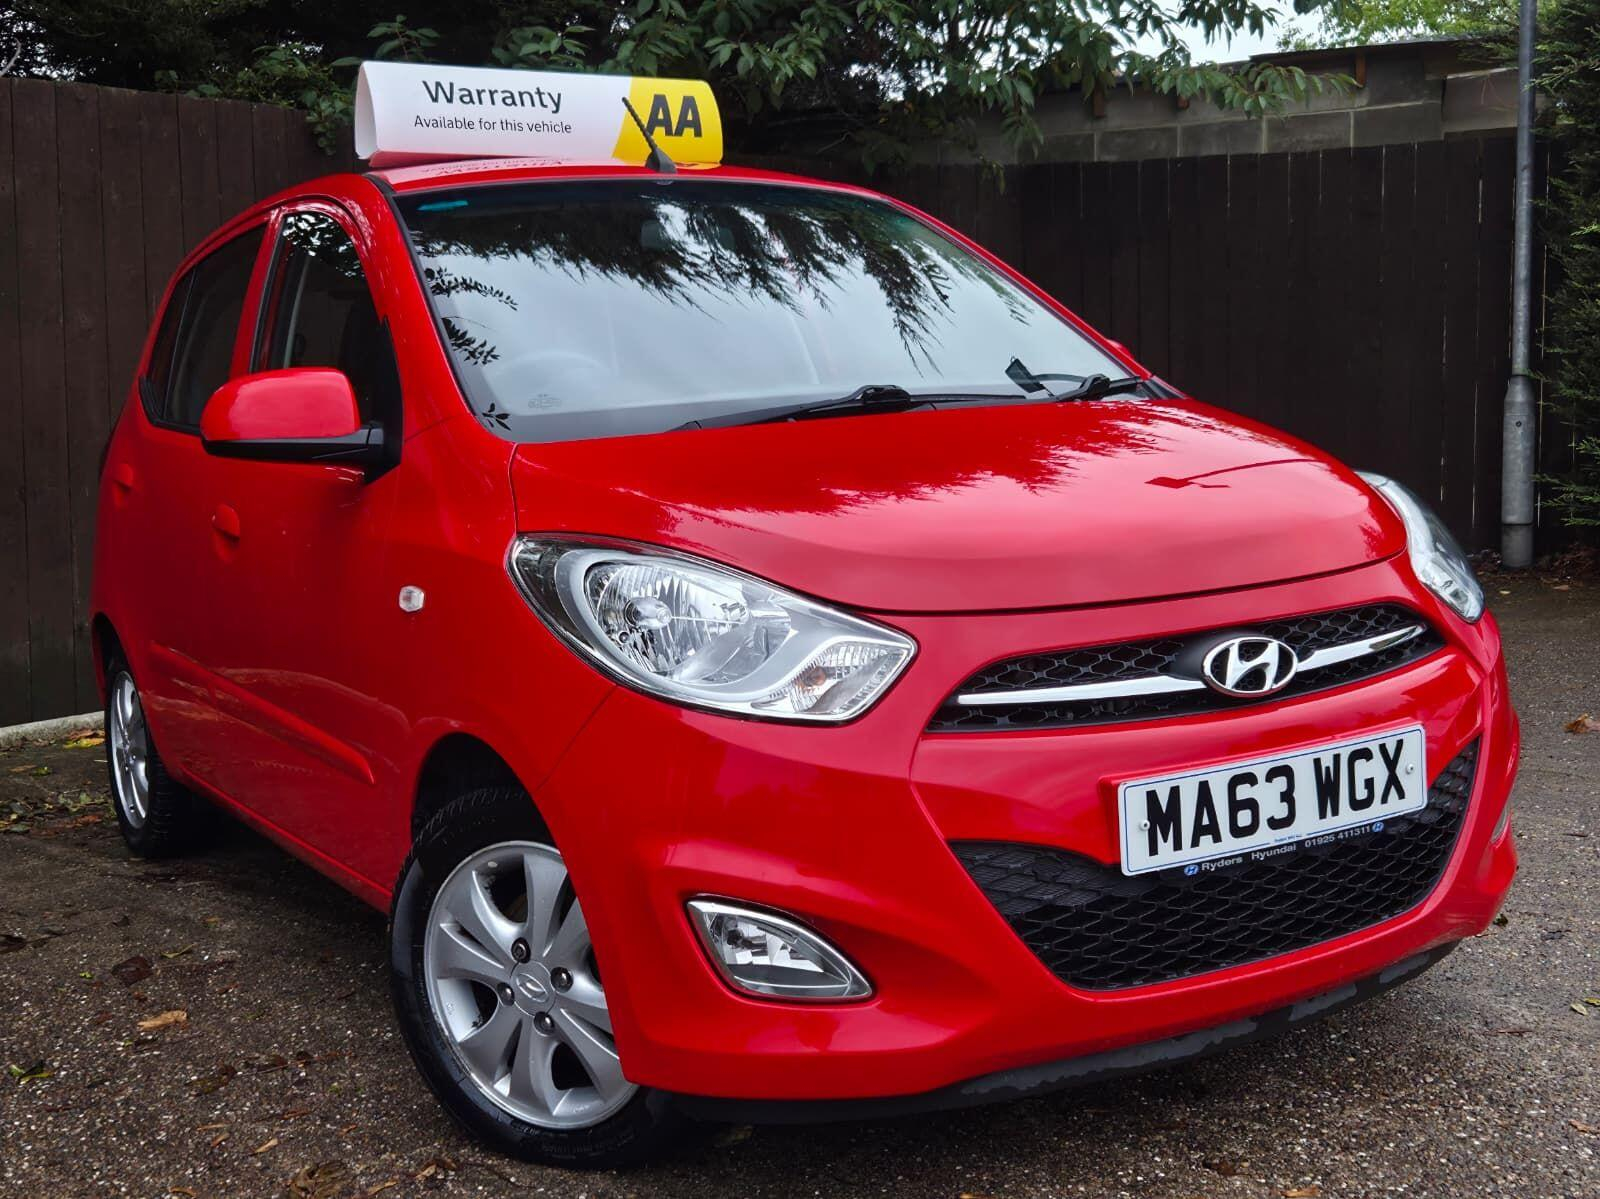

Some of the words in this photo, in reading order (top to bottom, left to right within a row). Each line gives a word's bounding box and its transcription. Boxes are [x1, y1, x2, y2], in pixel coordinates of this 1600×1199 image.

[422, 80, 562, 114] Warranty
[645, 93, 703, 138] AA
[414, 115, 475, 130] Available
[479, 117, 497, 131] for
[500, 119, 524, 132] this
[526, 121, 572, 134] vehicle
[1145, 764, 1296, 857] MA63
[1313, 739, 1406, 820] WGX
[1201, 855, 1243, 872] Ryders
[1251, 844, 1297, 861] Hyundai
[1304, 834, 1335, 848] 01925
